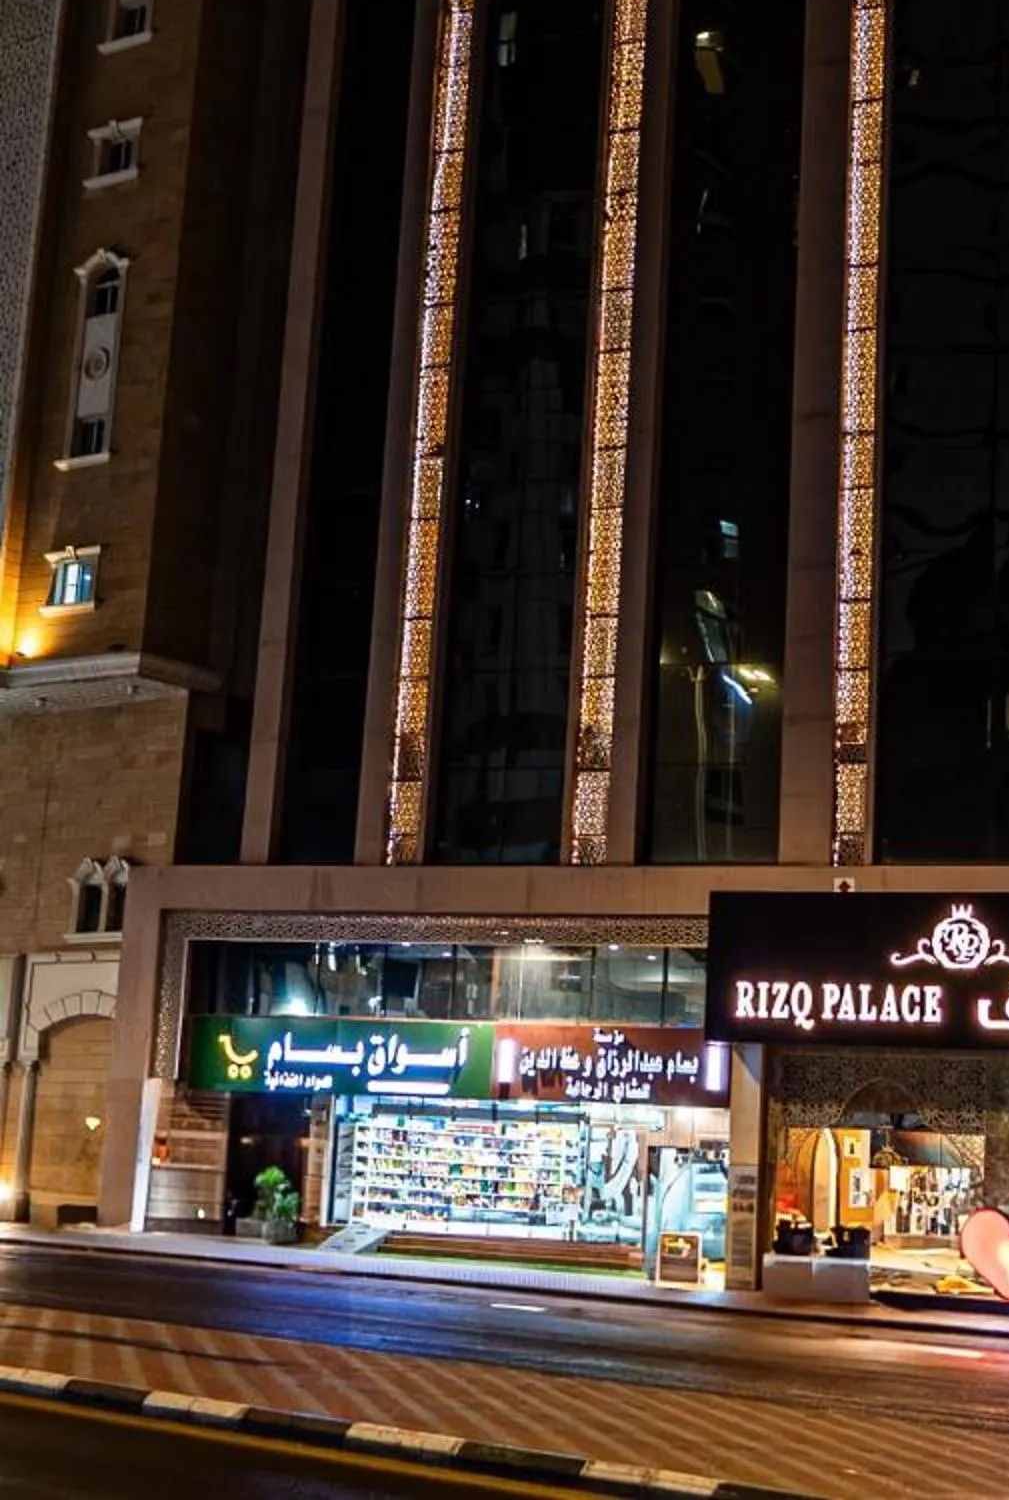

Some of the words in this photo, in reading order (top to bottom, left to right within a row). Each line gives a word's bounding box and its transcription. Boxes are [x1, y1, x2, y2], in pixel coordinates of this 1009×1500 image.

[735, 980, 815, 1031] RIZQ
[821, 982, 942, 1023] PALACE
[267, 1031, 364, 1077] بسام
[367, 1027, 470, 1077] أسواق
[667, 1051, 699, 1083] بسام
